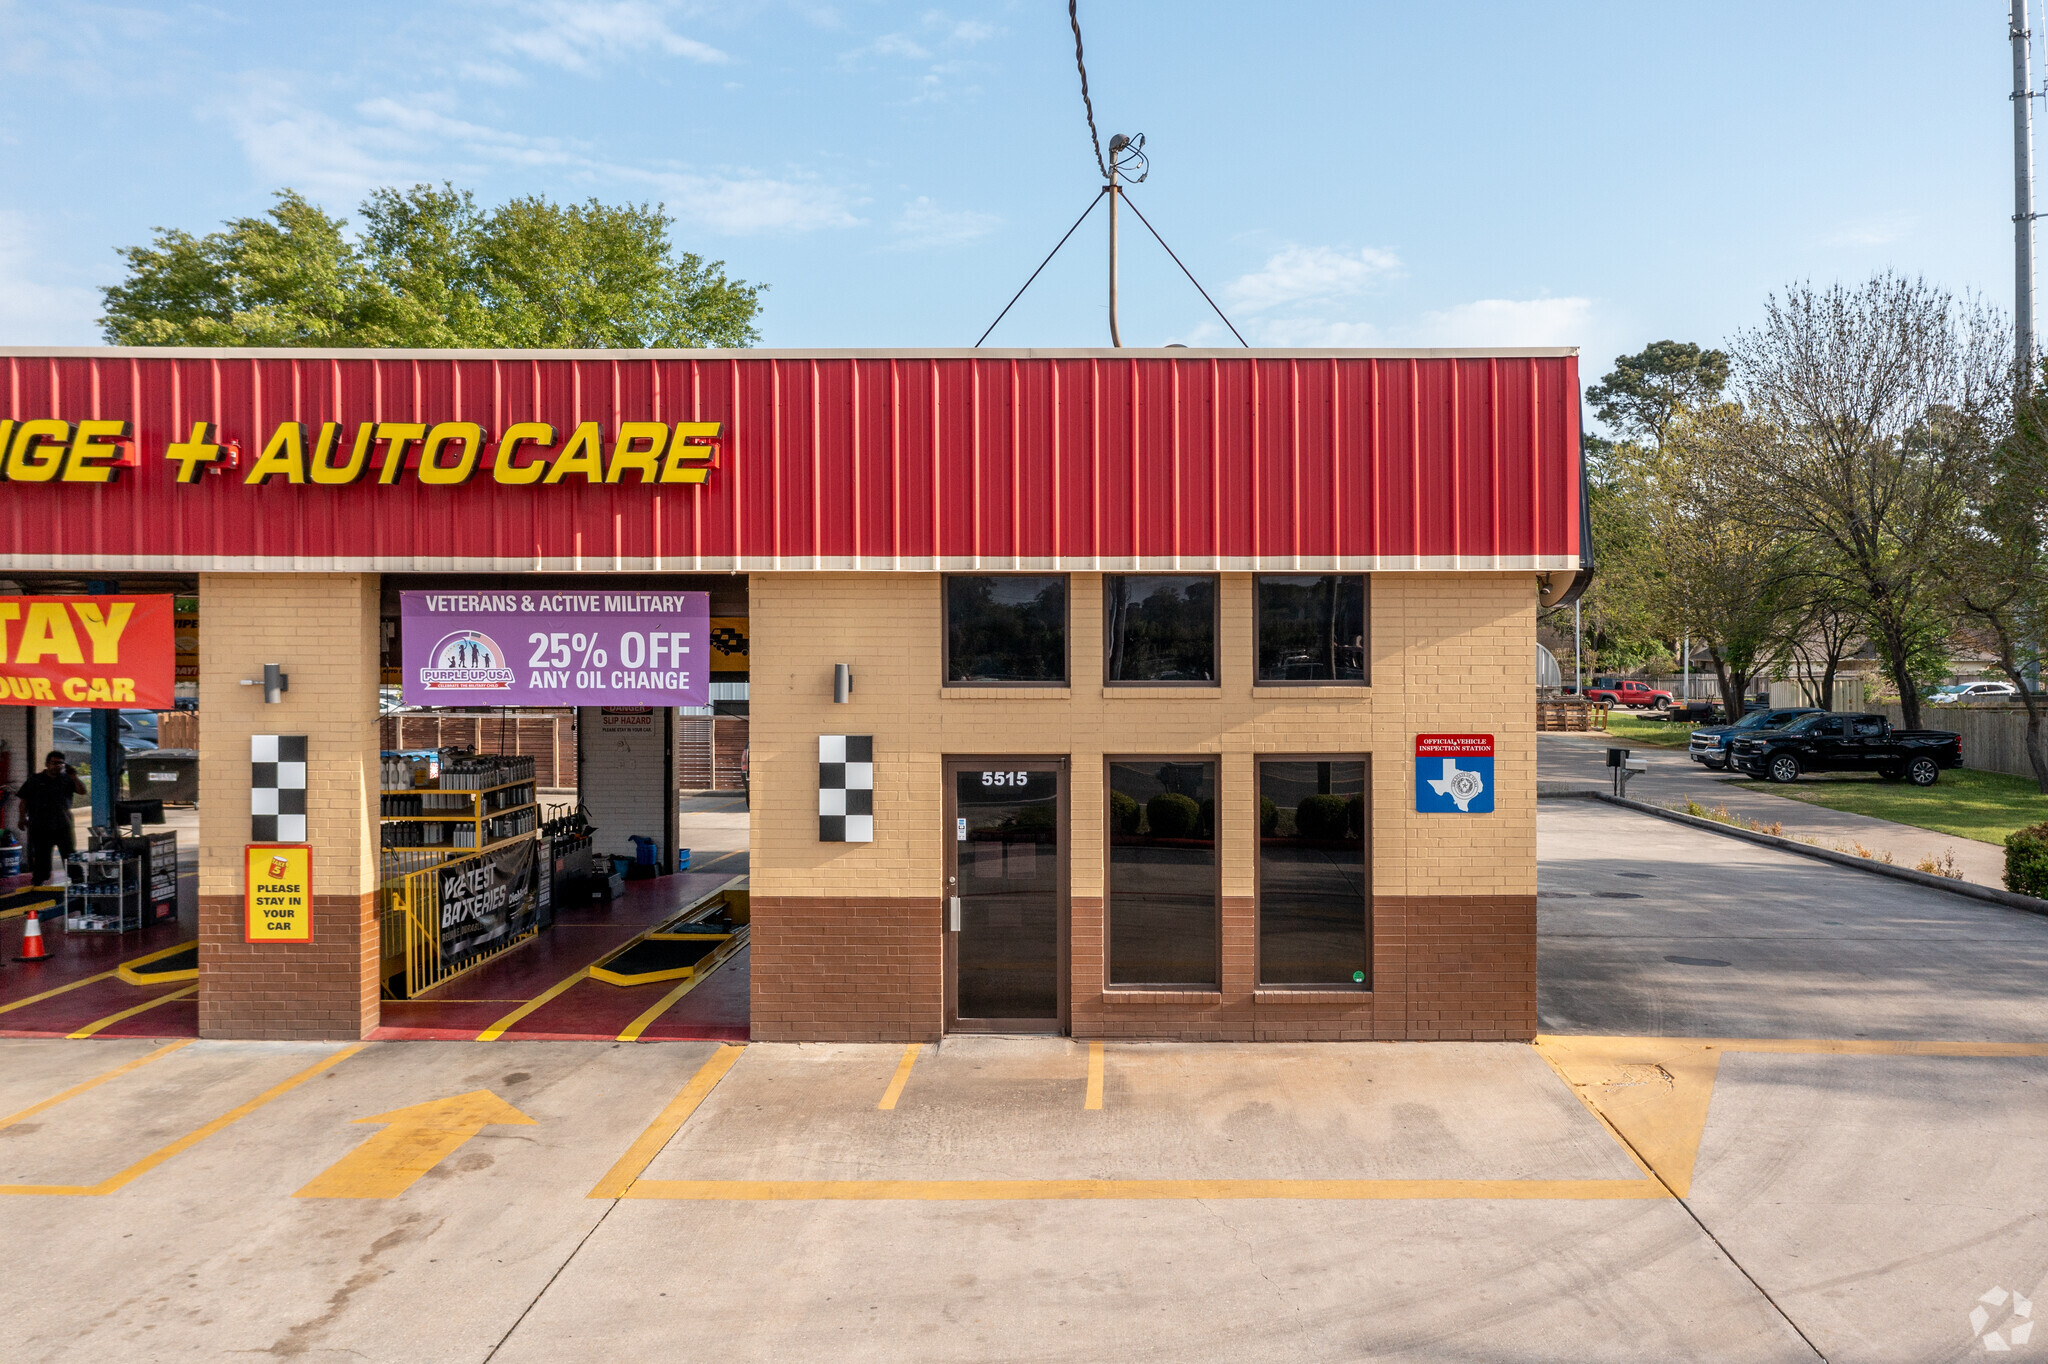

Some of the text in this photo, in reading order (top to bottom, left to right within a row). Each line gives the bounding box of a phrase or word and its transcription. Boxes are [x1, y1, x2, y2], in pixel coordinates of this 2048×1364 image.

[243, 421, 483, 485] AUTO
[492, 421, 722, 485] CARE
[425, 595, 685, 612] VETERANS & ACTIVE MILITARY
[174, 619, 199, 629] IPE
[528, 631, 691, 669] 25% OFF
[424, 671, 511, 680] PURPLE UP USA
[528, 671, 690, 690] ANY OIL CHANGE
[62, 677, 136, 702] CAR
[603, 716, 652, 725] SLIP HAZARD
[981, 771, 1028, 786] 5515
[467, 863, 496, 892] TEST
[257, 885, 300, 893] PLEASE
[256, 897, 301, 905] STAY IN
[441, 885, 507, 929] BATTERIES
[263, 910, 295, 918] YOUR
[267, 922, 291, 930] CAR
